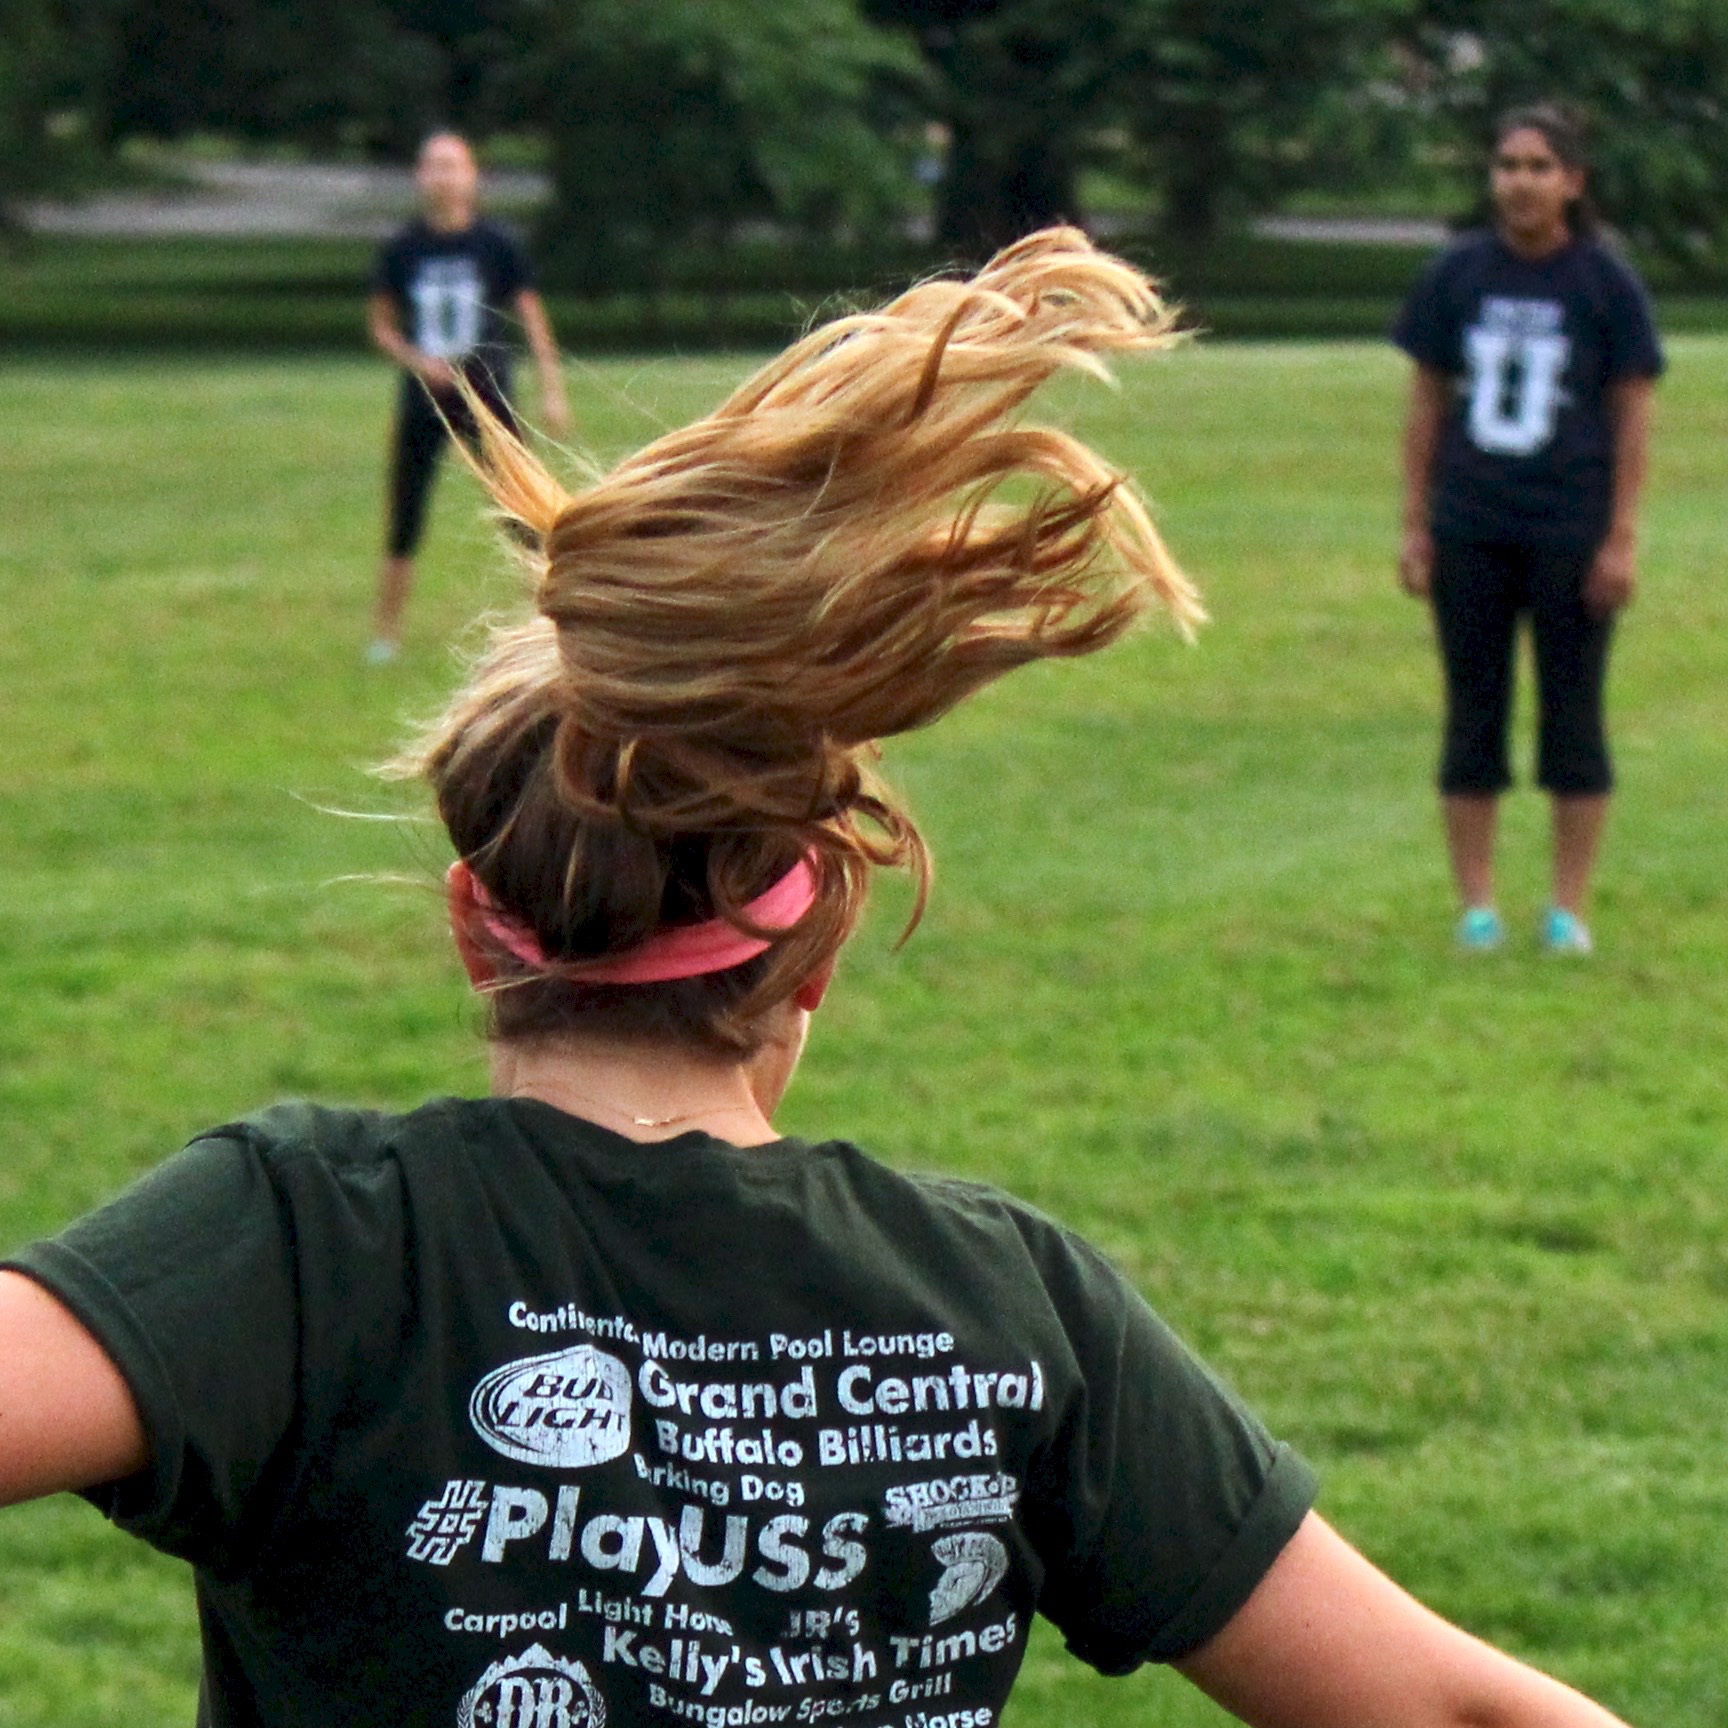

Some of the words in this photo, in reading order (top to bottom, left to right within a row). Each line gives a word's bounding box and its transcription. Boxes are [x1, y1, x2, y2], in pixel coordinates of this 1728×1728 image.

[643, 1331, 759, 1361] Modern
[770, 1329, 832, 1359] Pool
[843, 1329, 955, 1358] Lounge
[638, 1358, 818, 1420] Grand
[837, 1360, 1044, 1416] Central
[657, 1416, 804, 1468] Buffalo
[818, 1418, 998, 1467] Billiards
[740, 1474, 805, 1507] Dog
[443, 1602, 568, 1639] Carpool
[578, 1588, 654, 1627] Light
[782, 1606, 861, 1640] JR's
[603, 1625, 768, 1696] Kelly's
[770, 1643, 877, 1686] Irish
[890, 1612, 1017, 1670] Times
[888, 1672, 952, 1704] Grill
